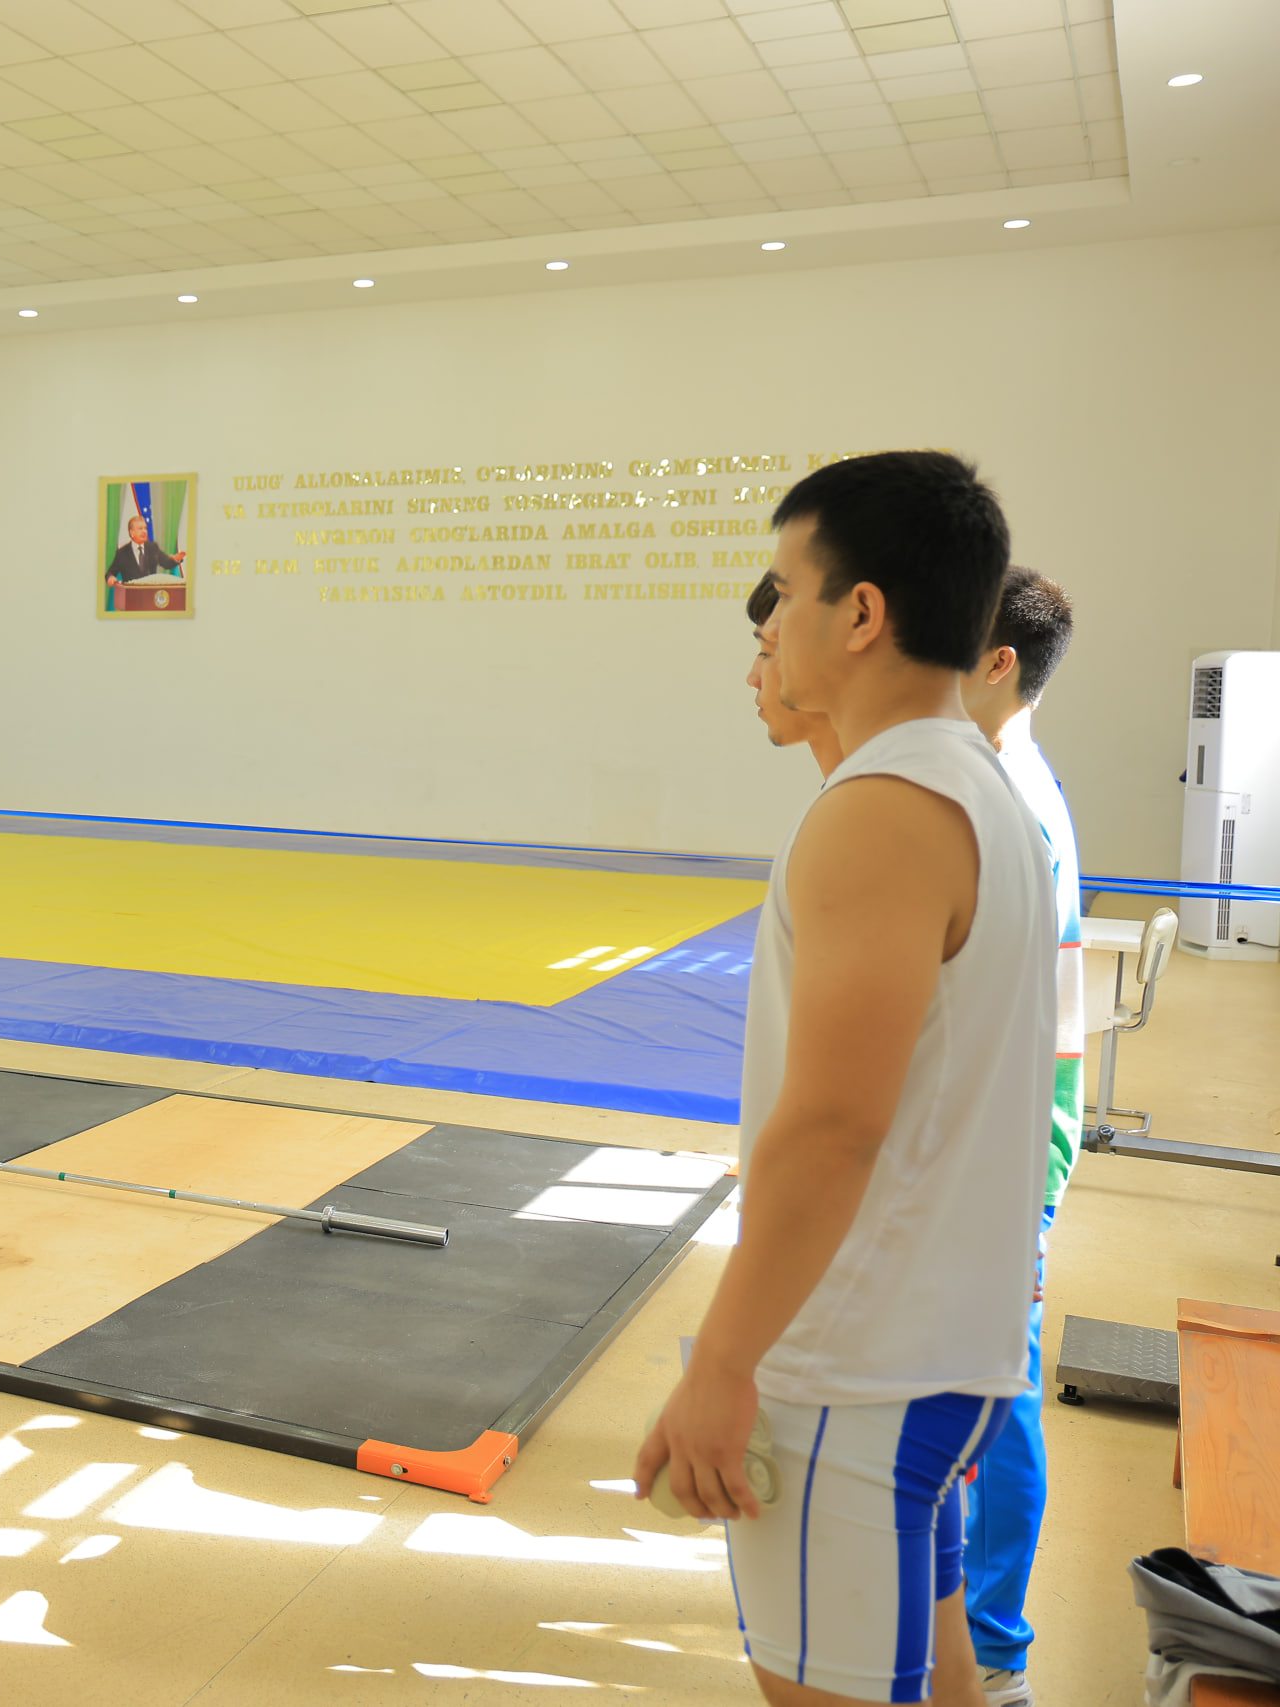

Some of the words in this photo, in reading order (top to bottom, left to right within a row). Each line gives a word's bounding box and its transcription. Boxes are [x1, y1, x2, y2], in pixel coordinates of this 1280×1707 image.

[222, 504, 246, 519] VA
[257, 500, 393, 518] IXTIROLARINI
[294, 528, 395, 546] NAVQIRON
[562, 521, 656, 540] AMALGA
[671, 518, 779, 537] OSHIRGA
[211, 560, 241, 575] SIZ
[313, 557, 379, 574] BUYUK
[396, 554, 551, 572] AJDODLARDAN
[566, 553, 631, 569] IBRAT
[712, 550, 777, 567] HAYO
[318, 585, 446, 602] YARATISHGA
[461, 583, 567, 602] ASTOYDIL
